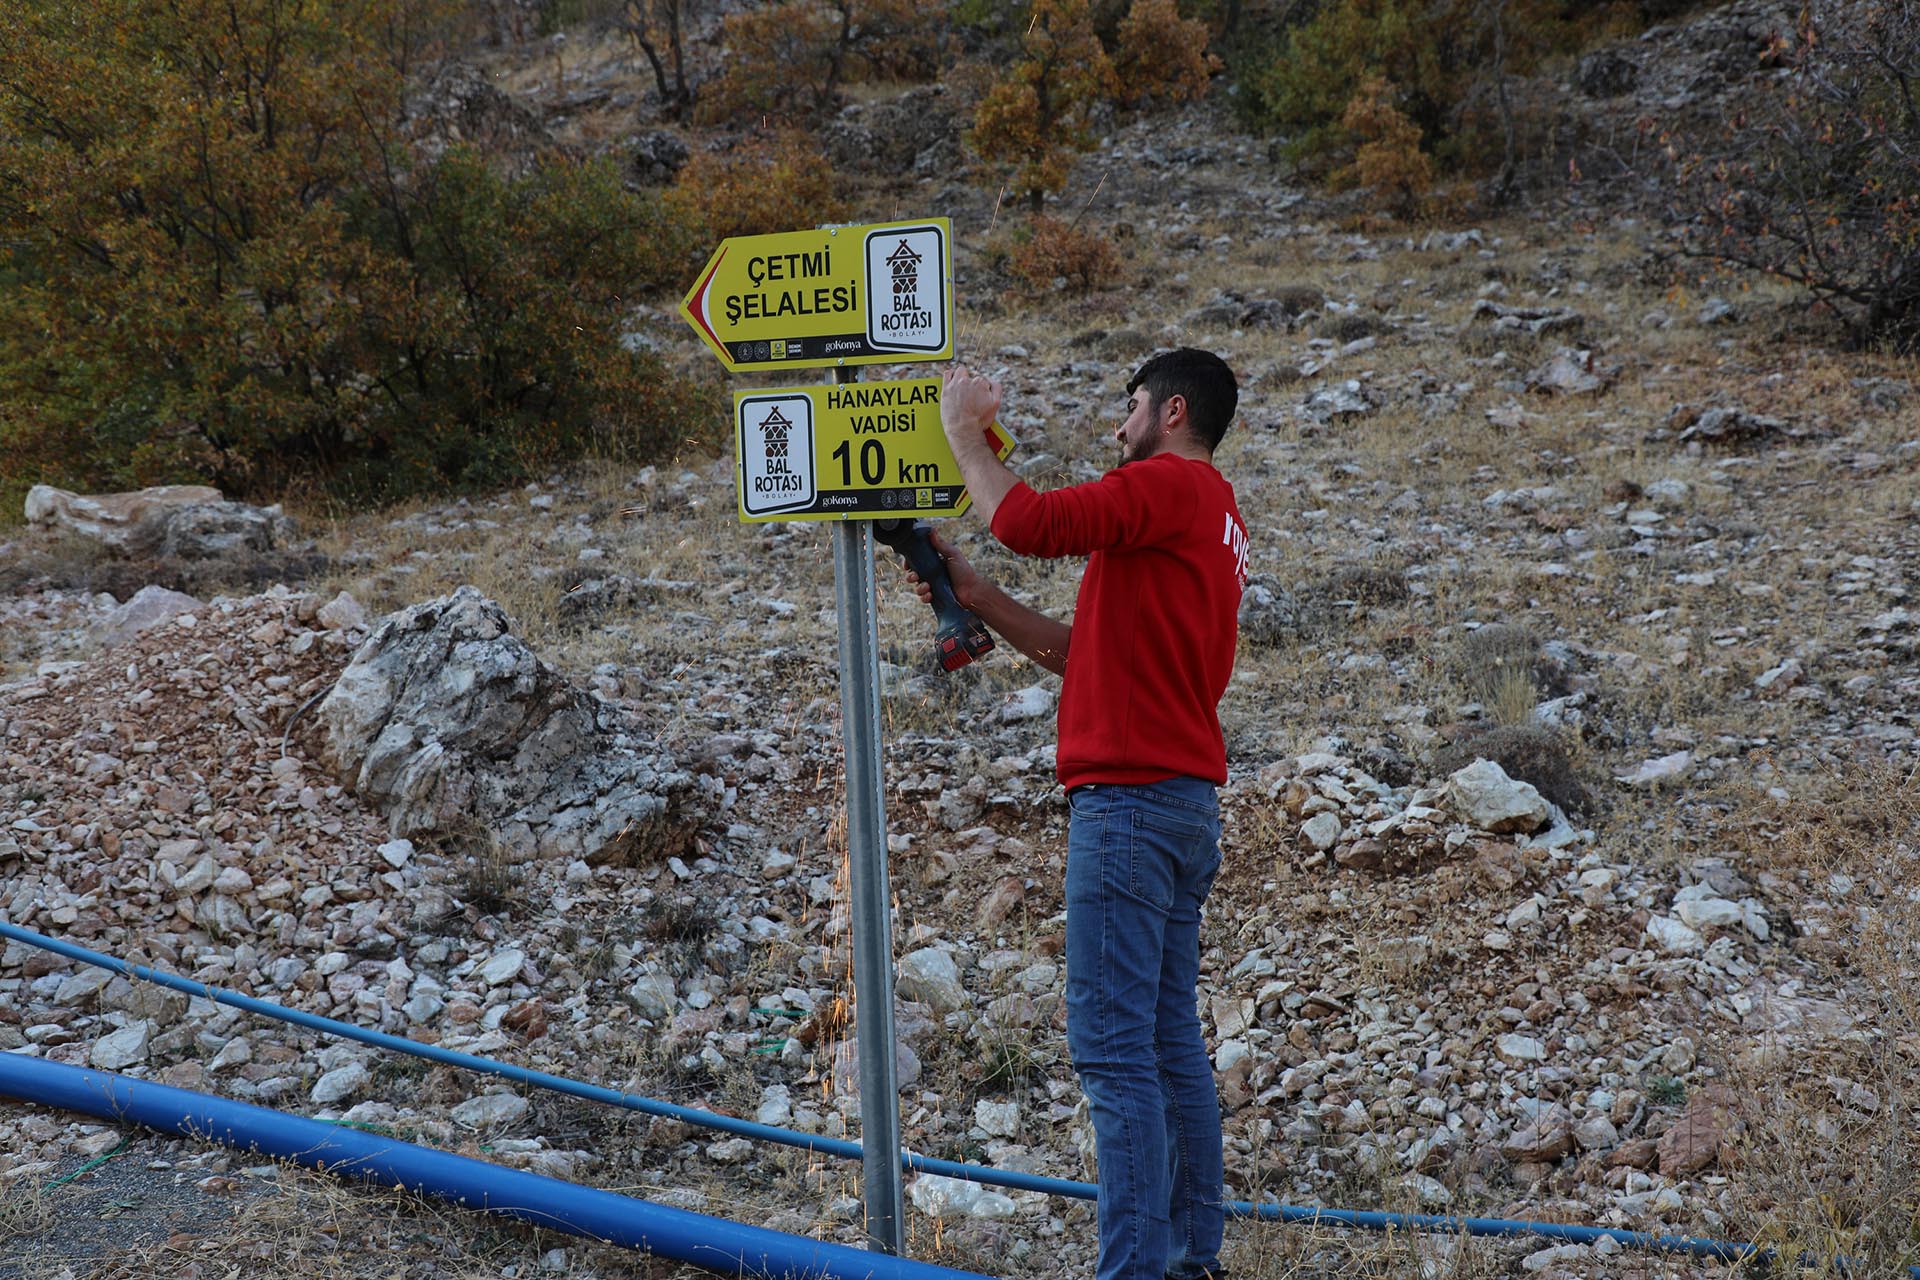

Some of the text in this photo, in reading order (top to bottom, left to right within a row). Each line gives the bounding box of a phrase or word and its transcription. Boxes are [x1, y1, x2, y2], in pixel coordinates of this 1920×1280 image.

[747, 244, 831, 288] ÇETMİ
[725, 279, 857, 326] ŞELALESİ
[893, 294, 921, 312] BAL
[881, 311, 932, 331] ROTASI
[825, 340, 862, 353] goKonya
[827, 385, 939, 409] HANAYLAR
[850, 408, 916, 434] VADİSİ
[766, 458, 793, 475] BAL
[832, 438, 939, 486] 10 km
[755, 475, 803, 492] ROTASI
[822, 495, 858, 507] goKonya
